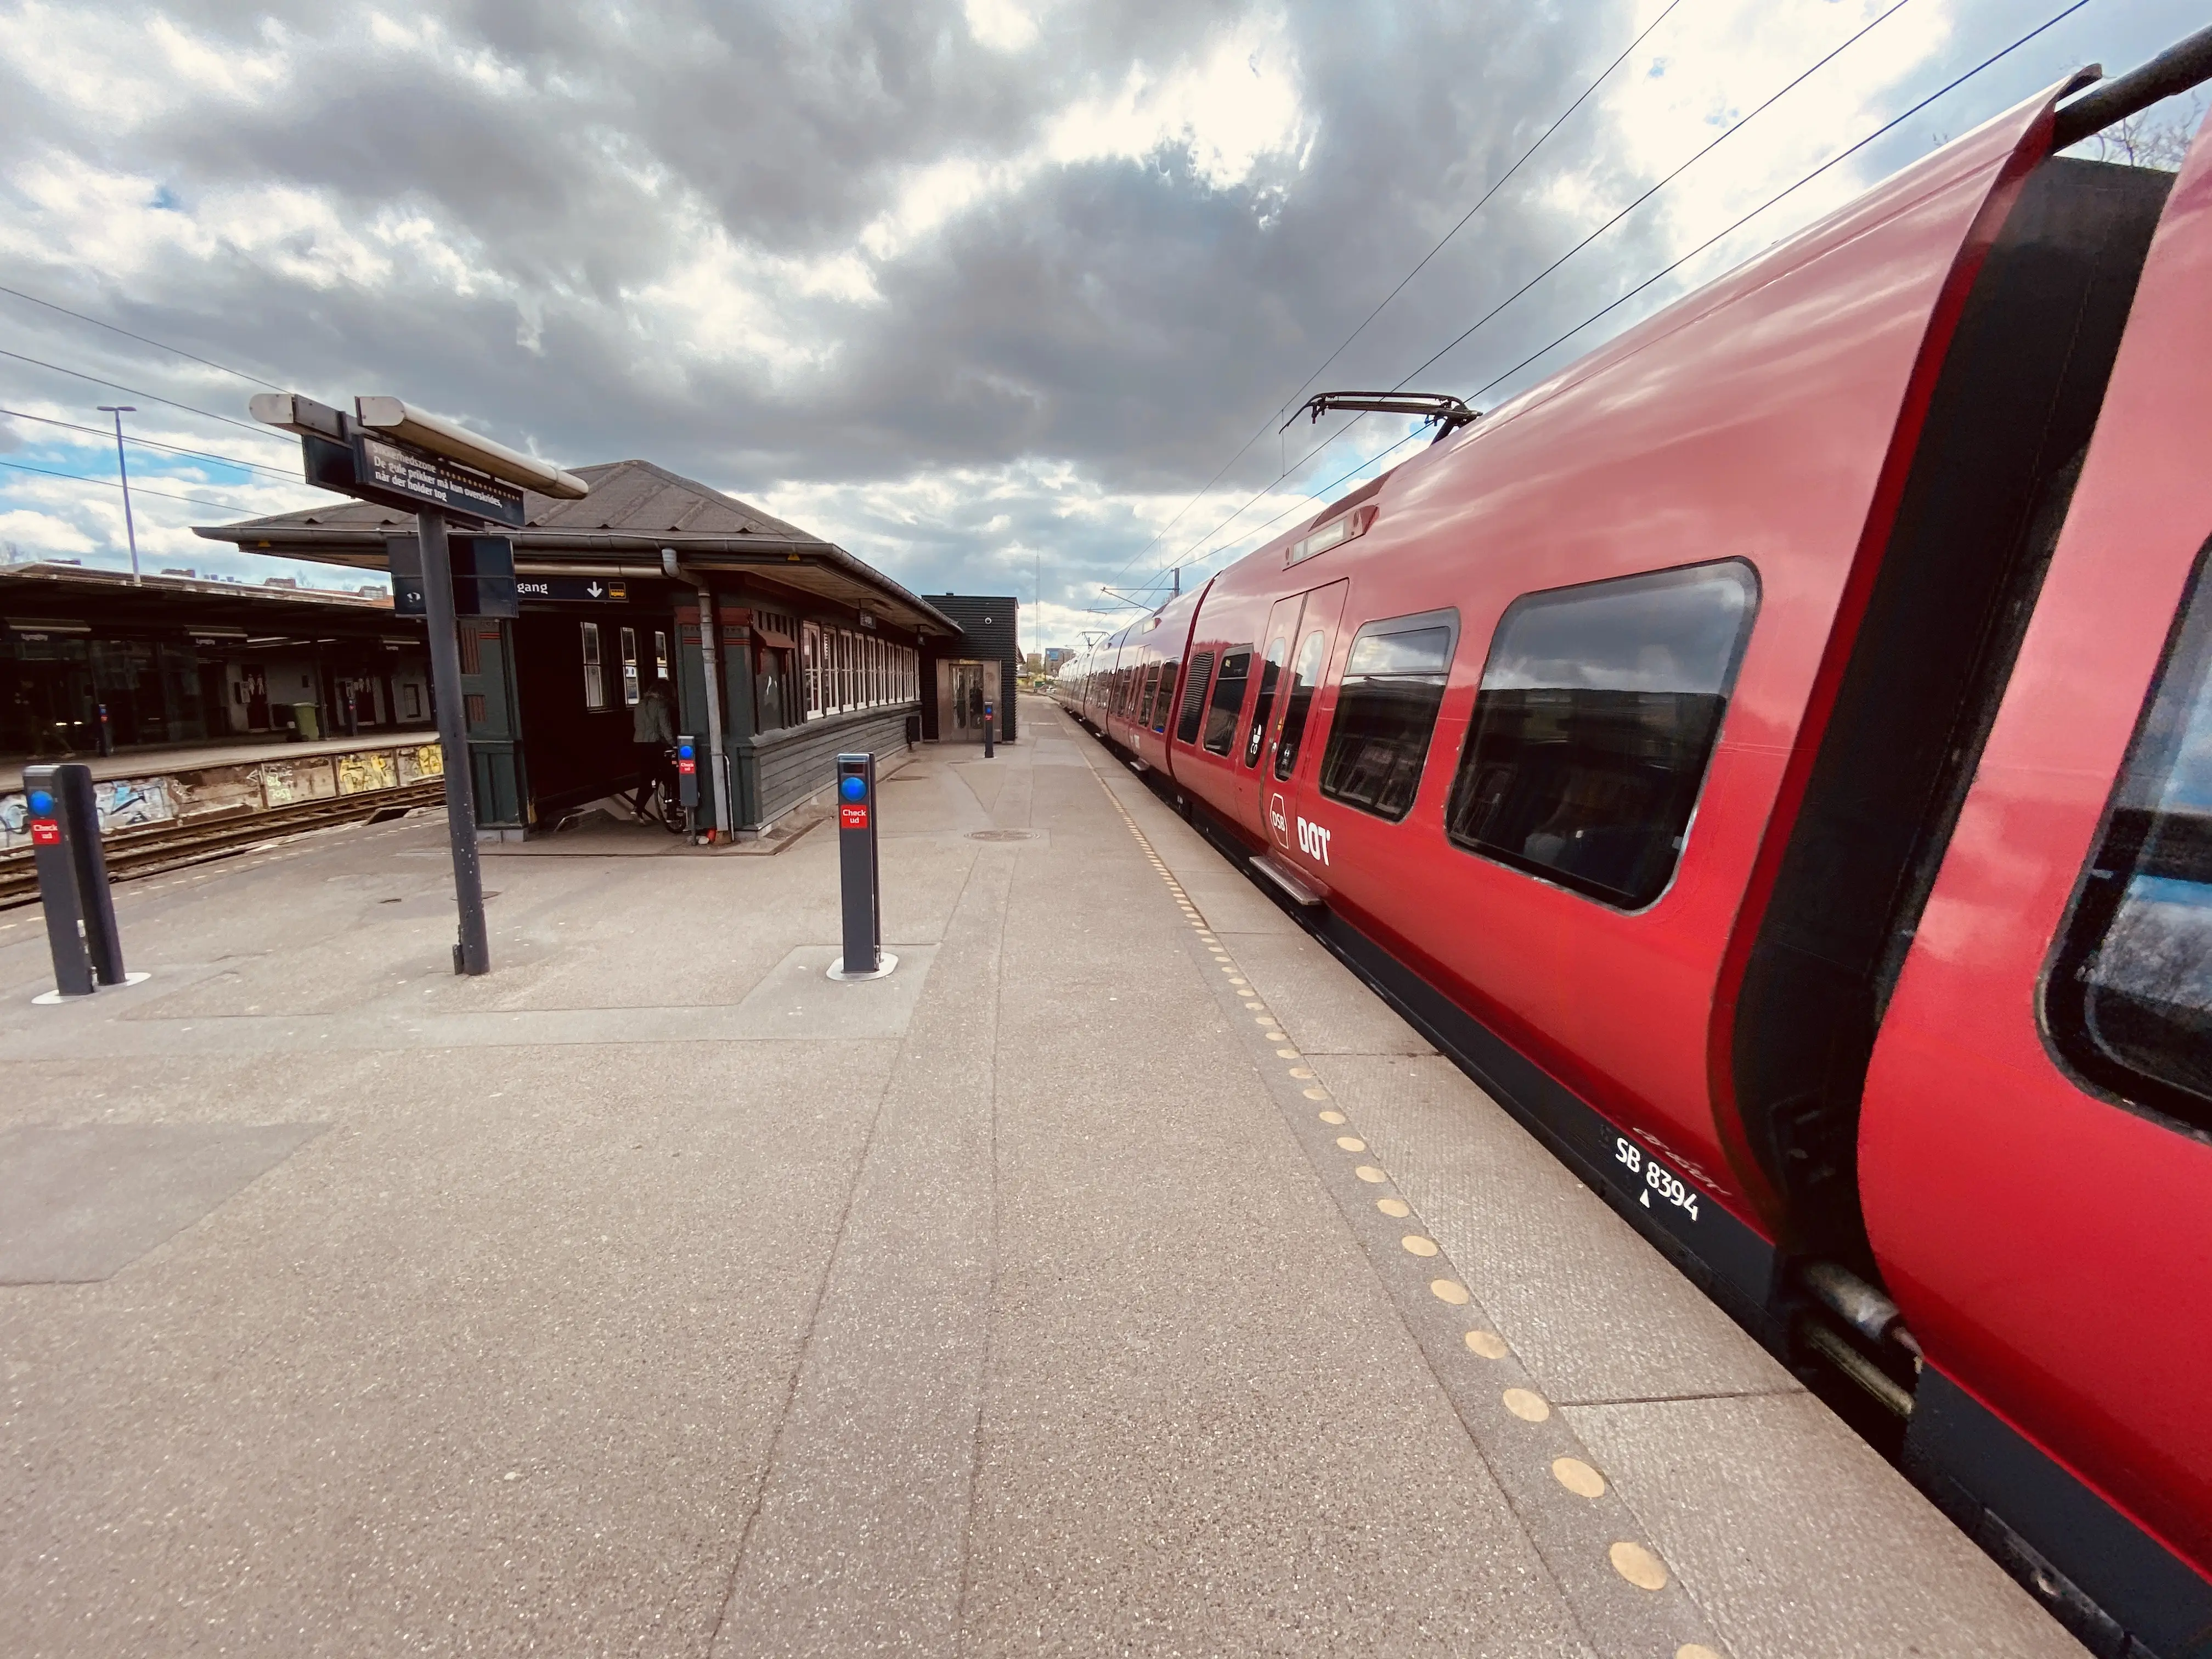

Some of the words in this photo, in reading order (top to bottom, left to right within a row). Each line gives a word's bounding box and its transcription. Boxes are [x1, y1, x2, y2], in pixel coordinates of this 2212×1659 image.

[374, 455, 386, 469] De
[388, 462, 407, 476] gule
[408, 470, 435, 484] prikker
[437, 478, 449, 489] må
[450, 481, 463, 494] kun
[375, 470, 390, 483] når
[392, 476, 406, 488] der
[408, 478, 433, 496] holder
[435, 491, 448, 503] tog
[1272, 811, 1285, 832] DSB
[1297, 816, 1330, 866] DOT
[1615, 1137, 1640, 1173] SB
[1646, 1161, 1698, 1222] 8394
